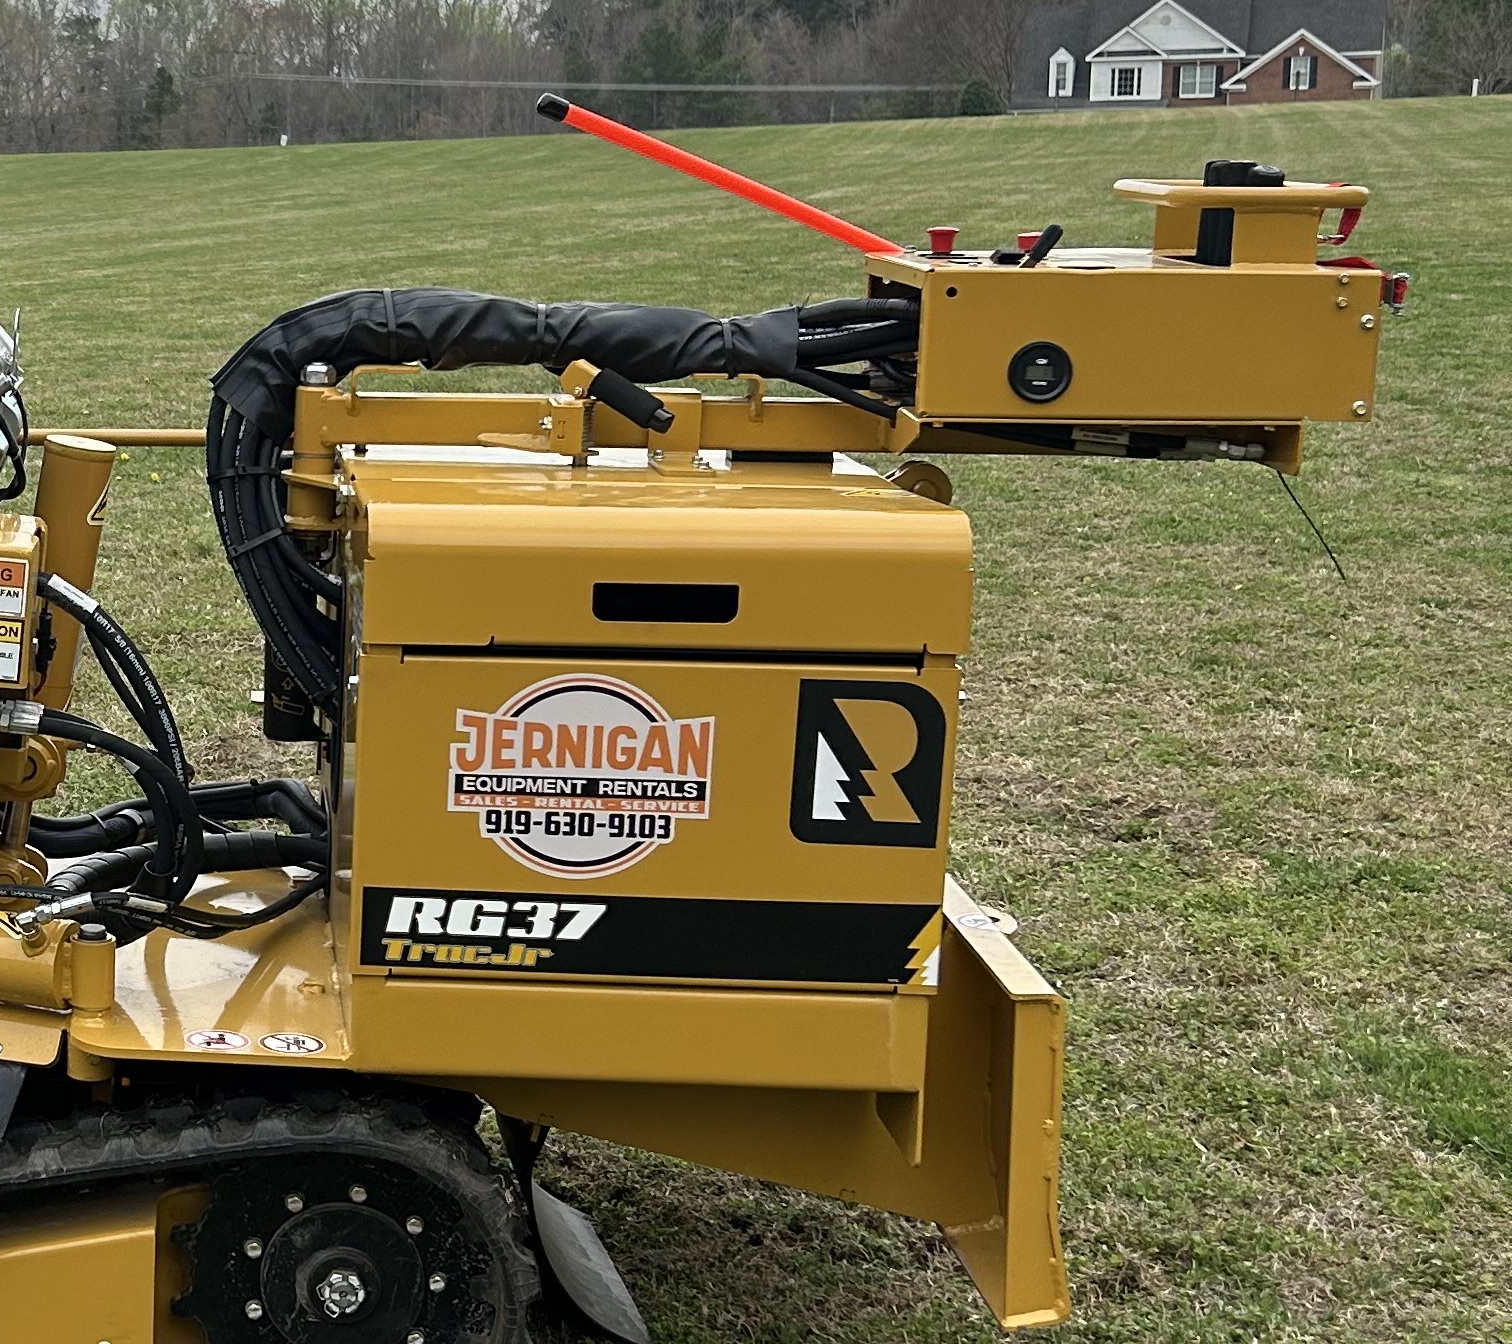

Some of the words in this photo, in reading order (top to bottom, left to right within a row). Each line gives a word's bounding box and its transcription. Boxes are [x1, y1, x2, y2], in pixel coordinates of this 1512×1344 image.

[0, 588, 20, 599] FAN
[456, 714, 710, 778] JERNIGAN
[462, 776, 588, 794] EQUIPMENT
[598, 779, 698, 798] RENTALS
[459, 794, 519, 807] SALES
[534, 796, 605, 810] RENTAL
[620, 799, 700, 814] SERVICE
[485, 809, 671, 839] 919-630-9103
[385, 896, 608, 941] RG37
